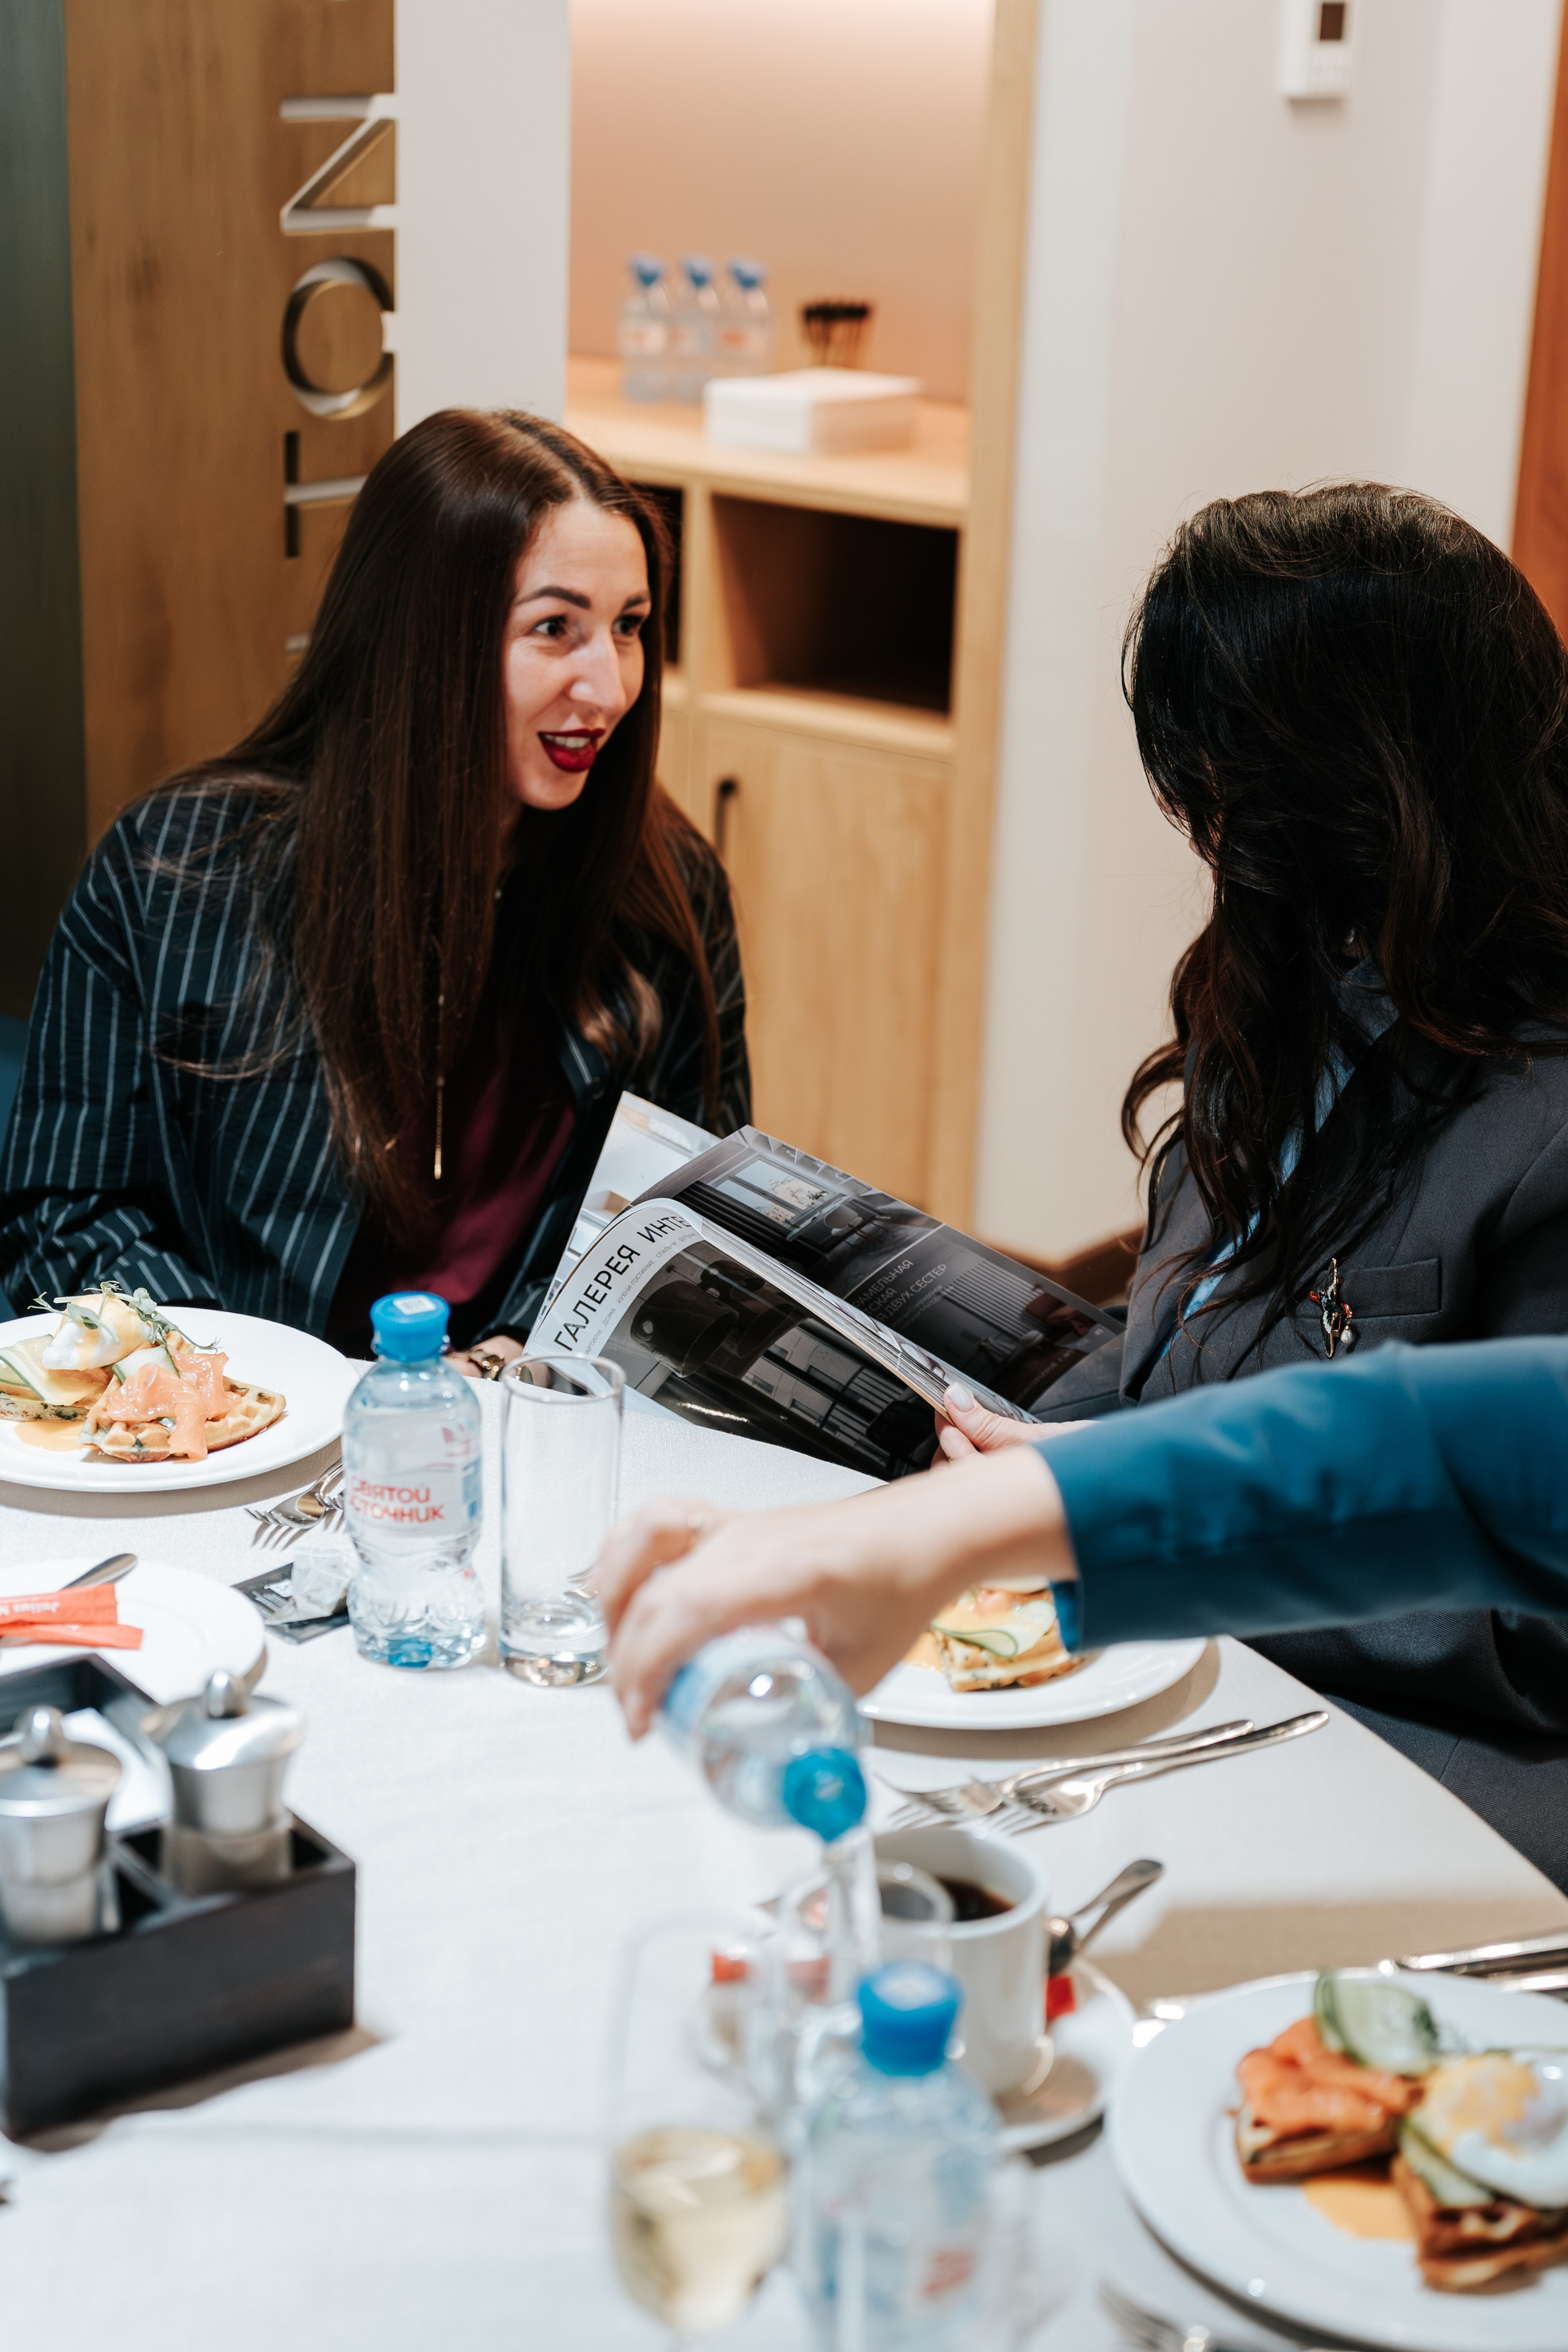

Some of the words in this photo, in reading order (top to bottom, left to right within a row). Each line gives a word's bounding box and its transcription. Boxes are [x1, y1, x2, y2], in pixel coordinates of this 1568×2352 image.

[280, 93, 397, 653] TON
[554, 1244, 641, 1352] ГАЛЕРЕЯ
[584, 1330, 602, 1355] АРТИРЫ
[602, 1308, 617, 1327] ДОМА
[617, 1259, 655, 1304] КУХНИ-ГОСТИНЫЕ
[885, 1291, 914, 1316] ДВУХ
[910, 1264, 947, 1292] СЕСТЕР
[349, 1494, 445, 1524] СТОЧНИК
[13, 1601, 60, 1613] Julius
